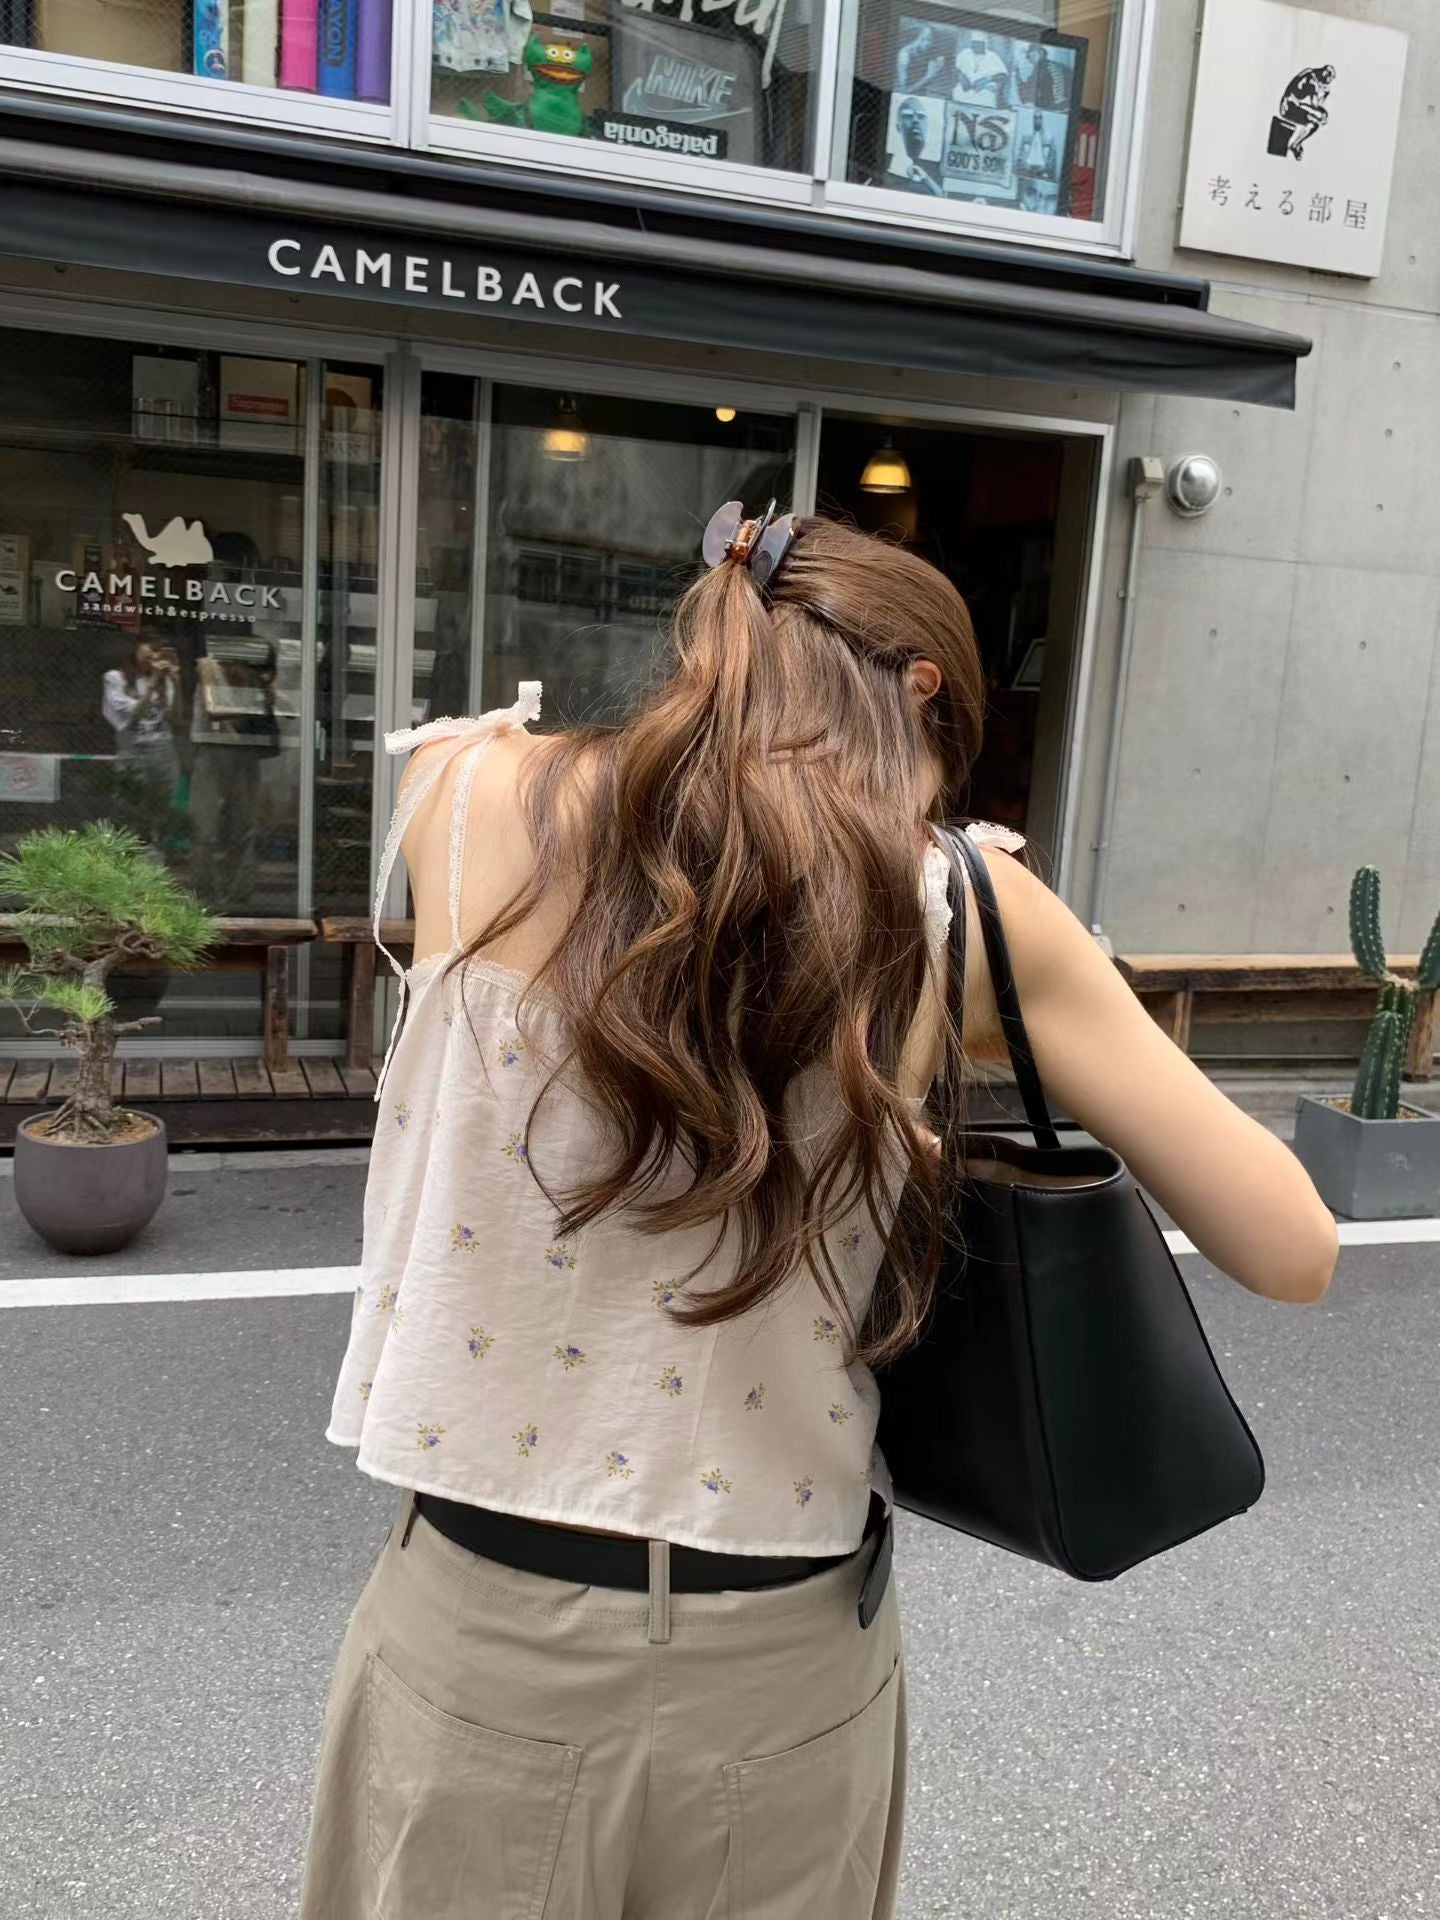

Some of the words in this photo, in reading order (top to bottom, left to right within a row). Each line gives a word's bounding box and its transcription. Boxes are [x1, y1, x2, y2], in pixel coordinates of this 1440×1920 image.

[643, 55, 737, 108] NIKE
[603, 121, 719, 156] patagonia
[1207, 175, 1368, 230] 考える部屋
[267, 239, 623, 319] CAMELBACK
[55, 569, 282, 610] CAMELBACK
